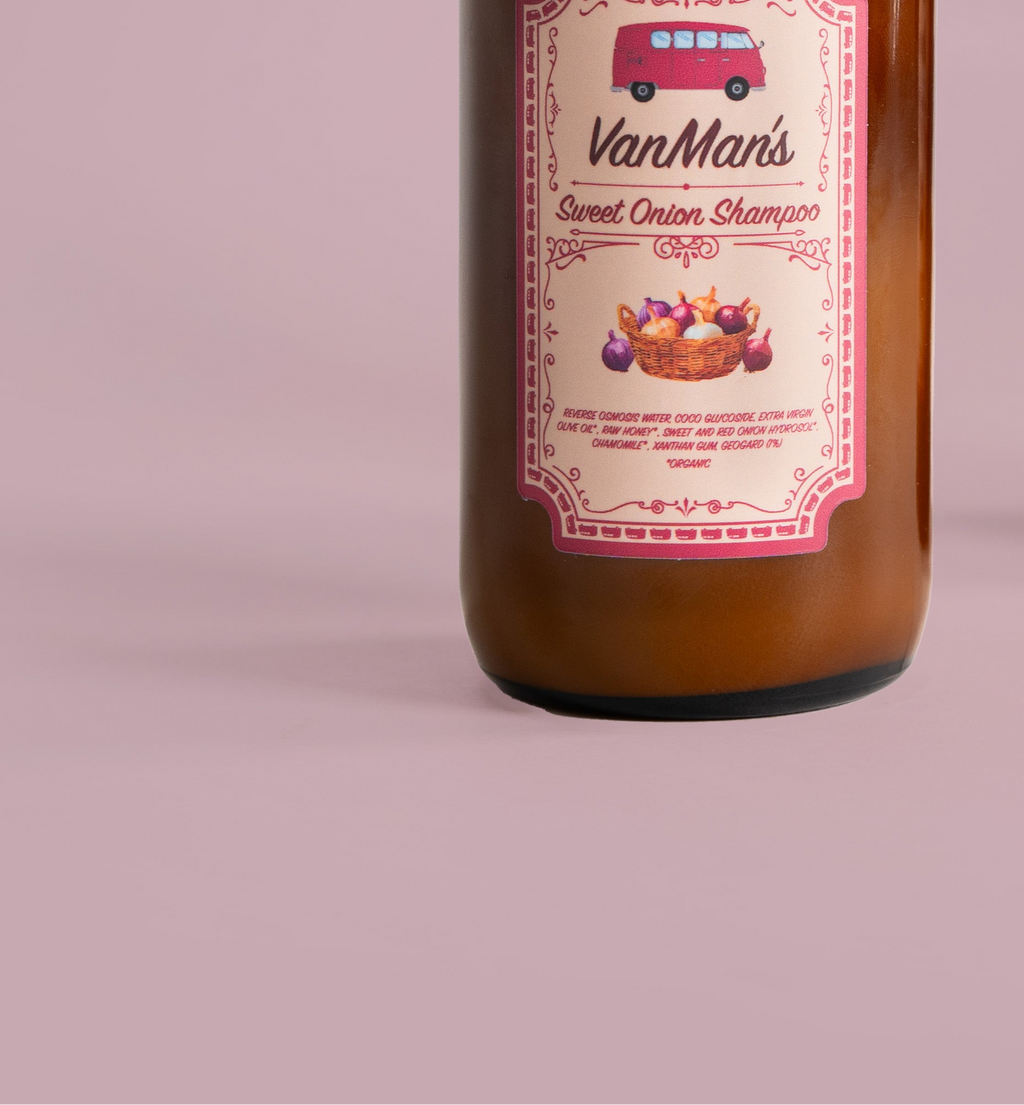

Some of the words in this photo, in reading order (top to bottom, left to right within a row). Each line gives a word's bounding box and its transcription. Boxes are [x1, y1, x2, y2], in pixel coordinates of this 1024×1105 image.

[589, 114, 795, 168] VanMan's
[555, 194, 624, 224] Sweet
[630, 197, 704, 225] Onion
[709, 196, 821, 232] Shampoo
[563, 408, 598, 420] REVERSE
[598, 411, 640, 423] OSMOSIS
[674, 413, 702, 423] COCO
[758, 410, 785, 422] EXTRA
[786, 408, 814, 419] VIRGIN
[557, 421, 580, 432] OLIVE
[601, 425, 622, 435] RAW
[662, 427, 694, 437] SWEET
[695, 427, 715, 437] AND
[716, 427, 736, 437] RED
[737, 425, 768, 437] ONION
[652, 441, 695, 451] XANTHAN
[720, 439, 764, 451] GEOGARD
